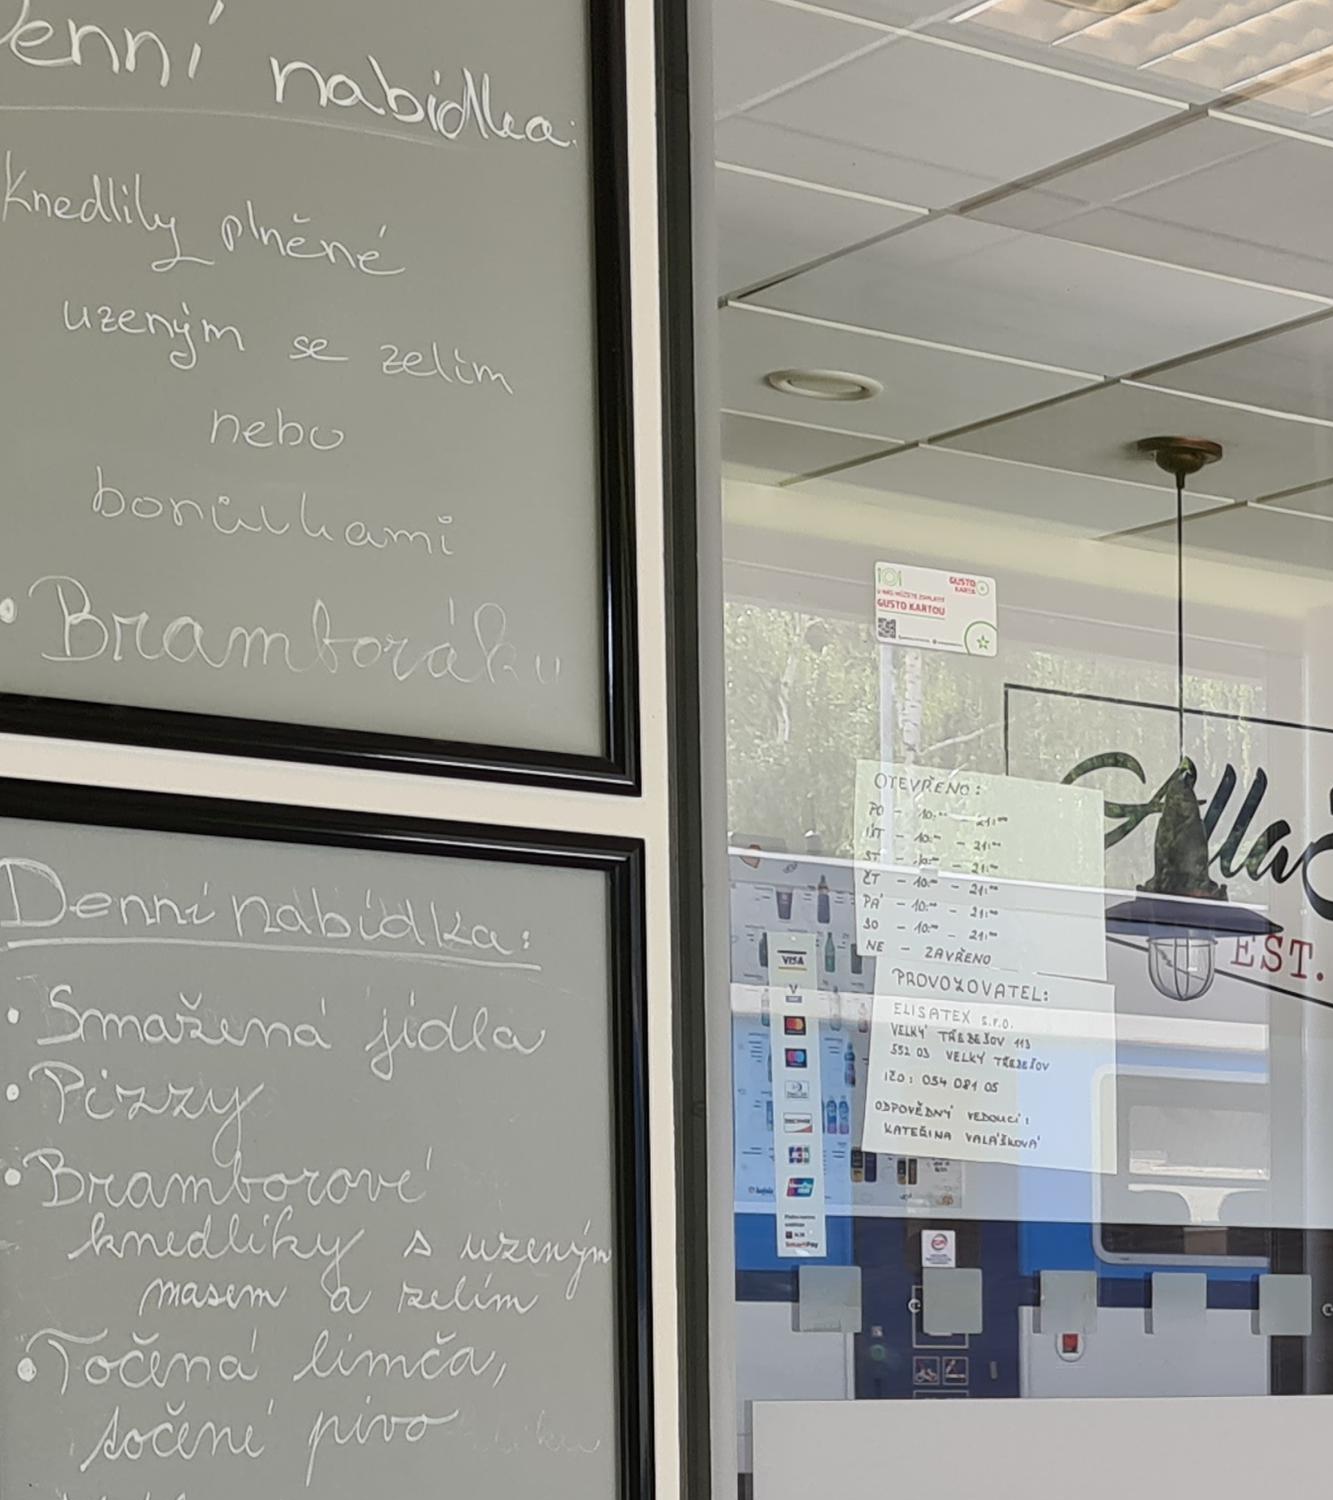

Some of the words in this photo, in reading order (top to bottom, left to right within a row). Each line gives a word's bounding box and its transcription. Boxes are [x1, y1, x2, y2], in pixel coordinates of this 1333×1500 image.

[289, 335, 350, 361] se
[210, 408, 345, 450] nebo
[876, 598, 907, 611] GUSTO
[781, 955, 805, 965] VISA
[925, 946, 992, 965] ZAVŘENO
[1230, 934, 1325, 983] EST.
[894, 1002, 971, 1024] ELISATEX
